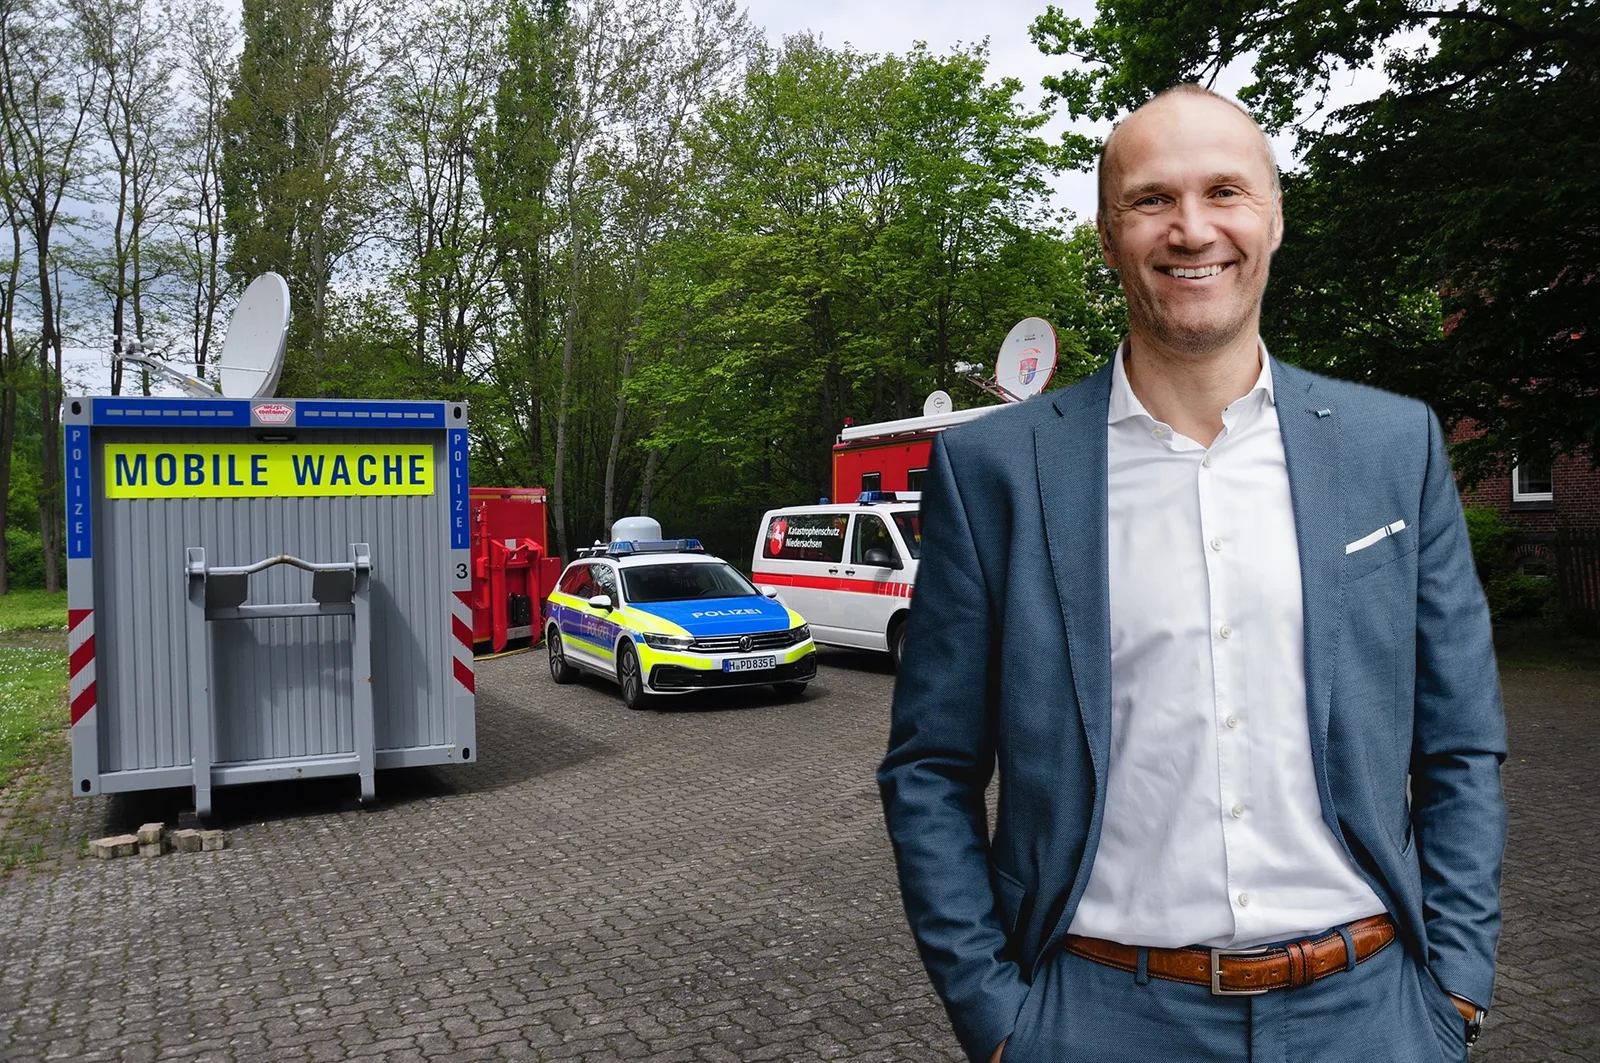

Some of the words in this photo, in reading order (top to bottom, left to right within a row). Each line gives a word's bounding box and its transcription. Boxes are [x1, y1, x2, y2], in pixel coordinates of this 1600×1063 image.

[115, 453, 268, 487] MOBILE
[292, 453, 426, 486] WACHE
[72, 430, 83, 552] POLIZEI
[454, 434, 463, 545] POLIZEI
[787, 525, 840, 537] Katastrophenschutz
[785, 538, 823, 549] Niedersachsen
[455, 563, 468, 579] 3
[691, 608, 763, 619] POLIZEI
[587, 621, 609, 640] POLIZEI
